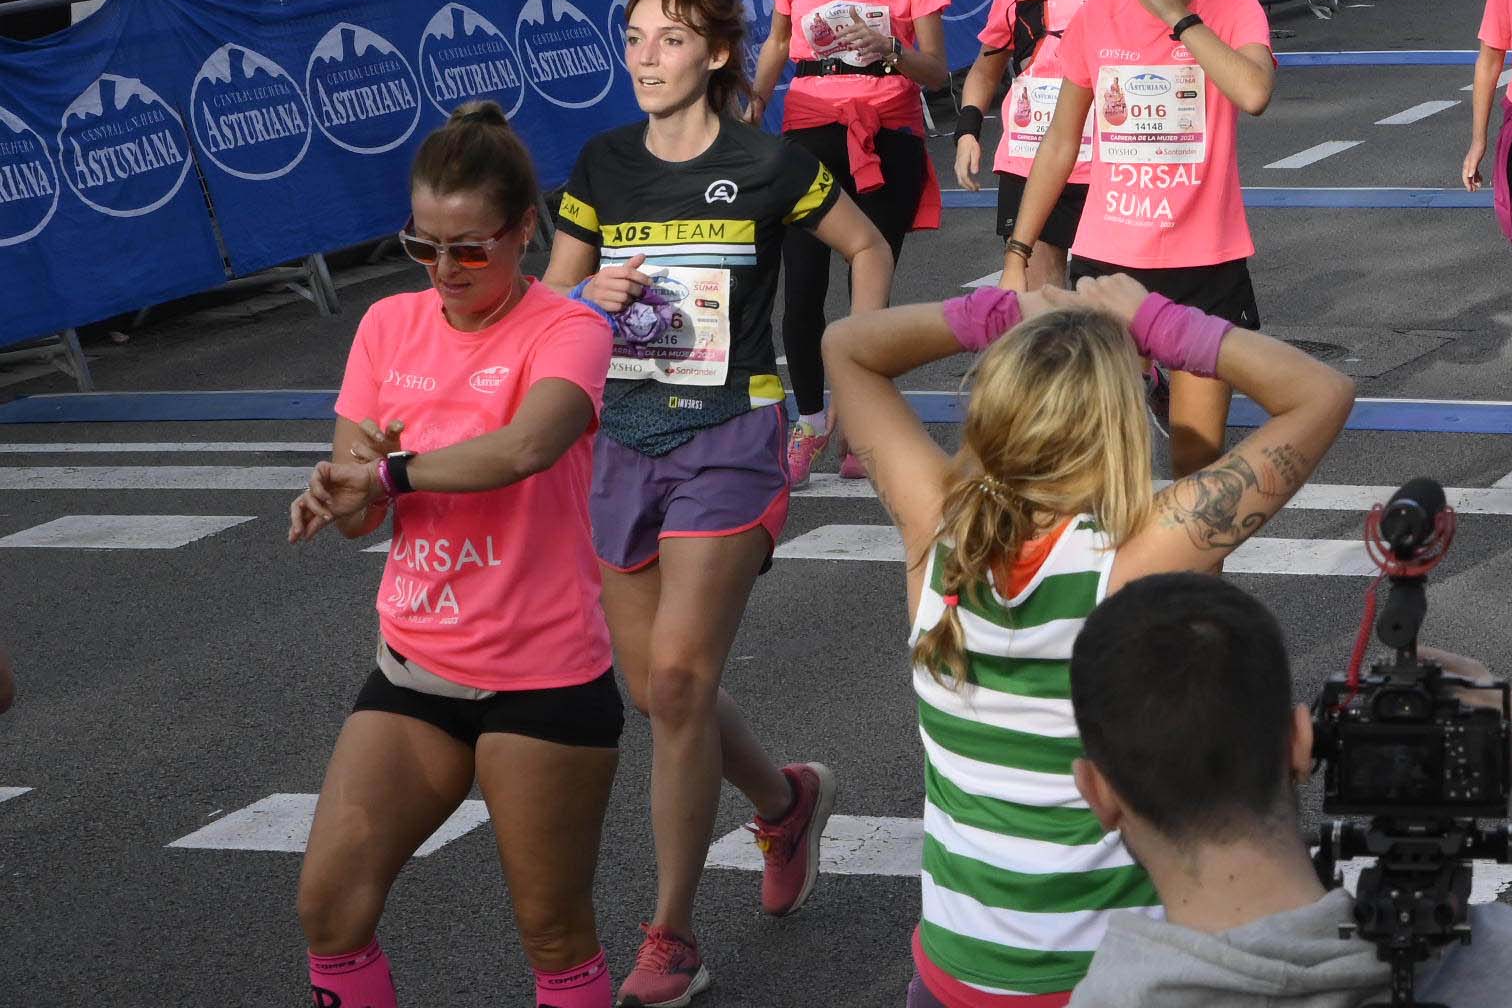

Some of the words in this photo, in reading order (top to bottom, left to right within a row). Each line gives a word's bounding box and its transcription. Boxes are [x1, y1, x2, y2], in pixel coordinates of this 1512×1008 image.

[524, 37, 611, 84] ASTURIANA
[1099, 47, 1142, 62] OYSHO
[428, 53, 521, 103] ASTURIANA
[1127, 80, 1169, 92] ASTURIANA
[316, 76, 417, 129] ASTURIANA
[1130, 104, 1167, 118] 016
[202, 100, 307, 154] ASTURIANA
[1135, 121, 1163, 132] 14148
[1110, 134, 1137, 142] CARRERA
[1137, 134, 1148, 142] DE
[1107, 147, 1138, 157] OYSHO
[1105, 191, 1174, 221] SUMA
[612, 225, 651, 243] AOS
[661, 223, 725, 241] TEAM
[694, 283, 719, 293] SUMA
[675, 366, 718, 377] Santander
